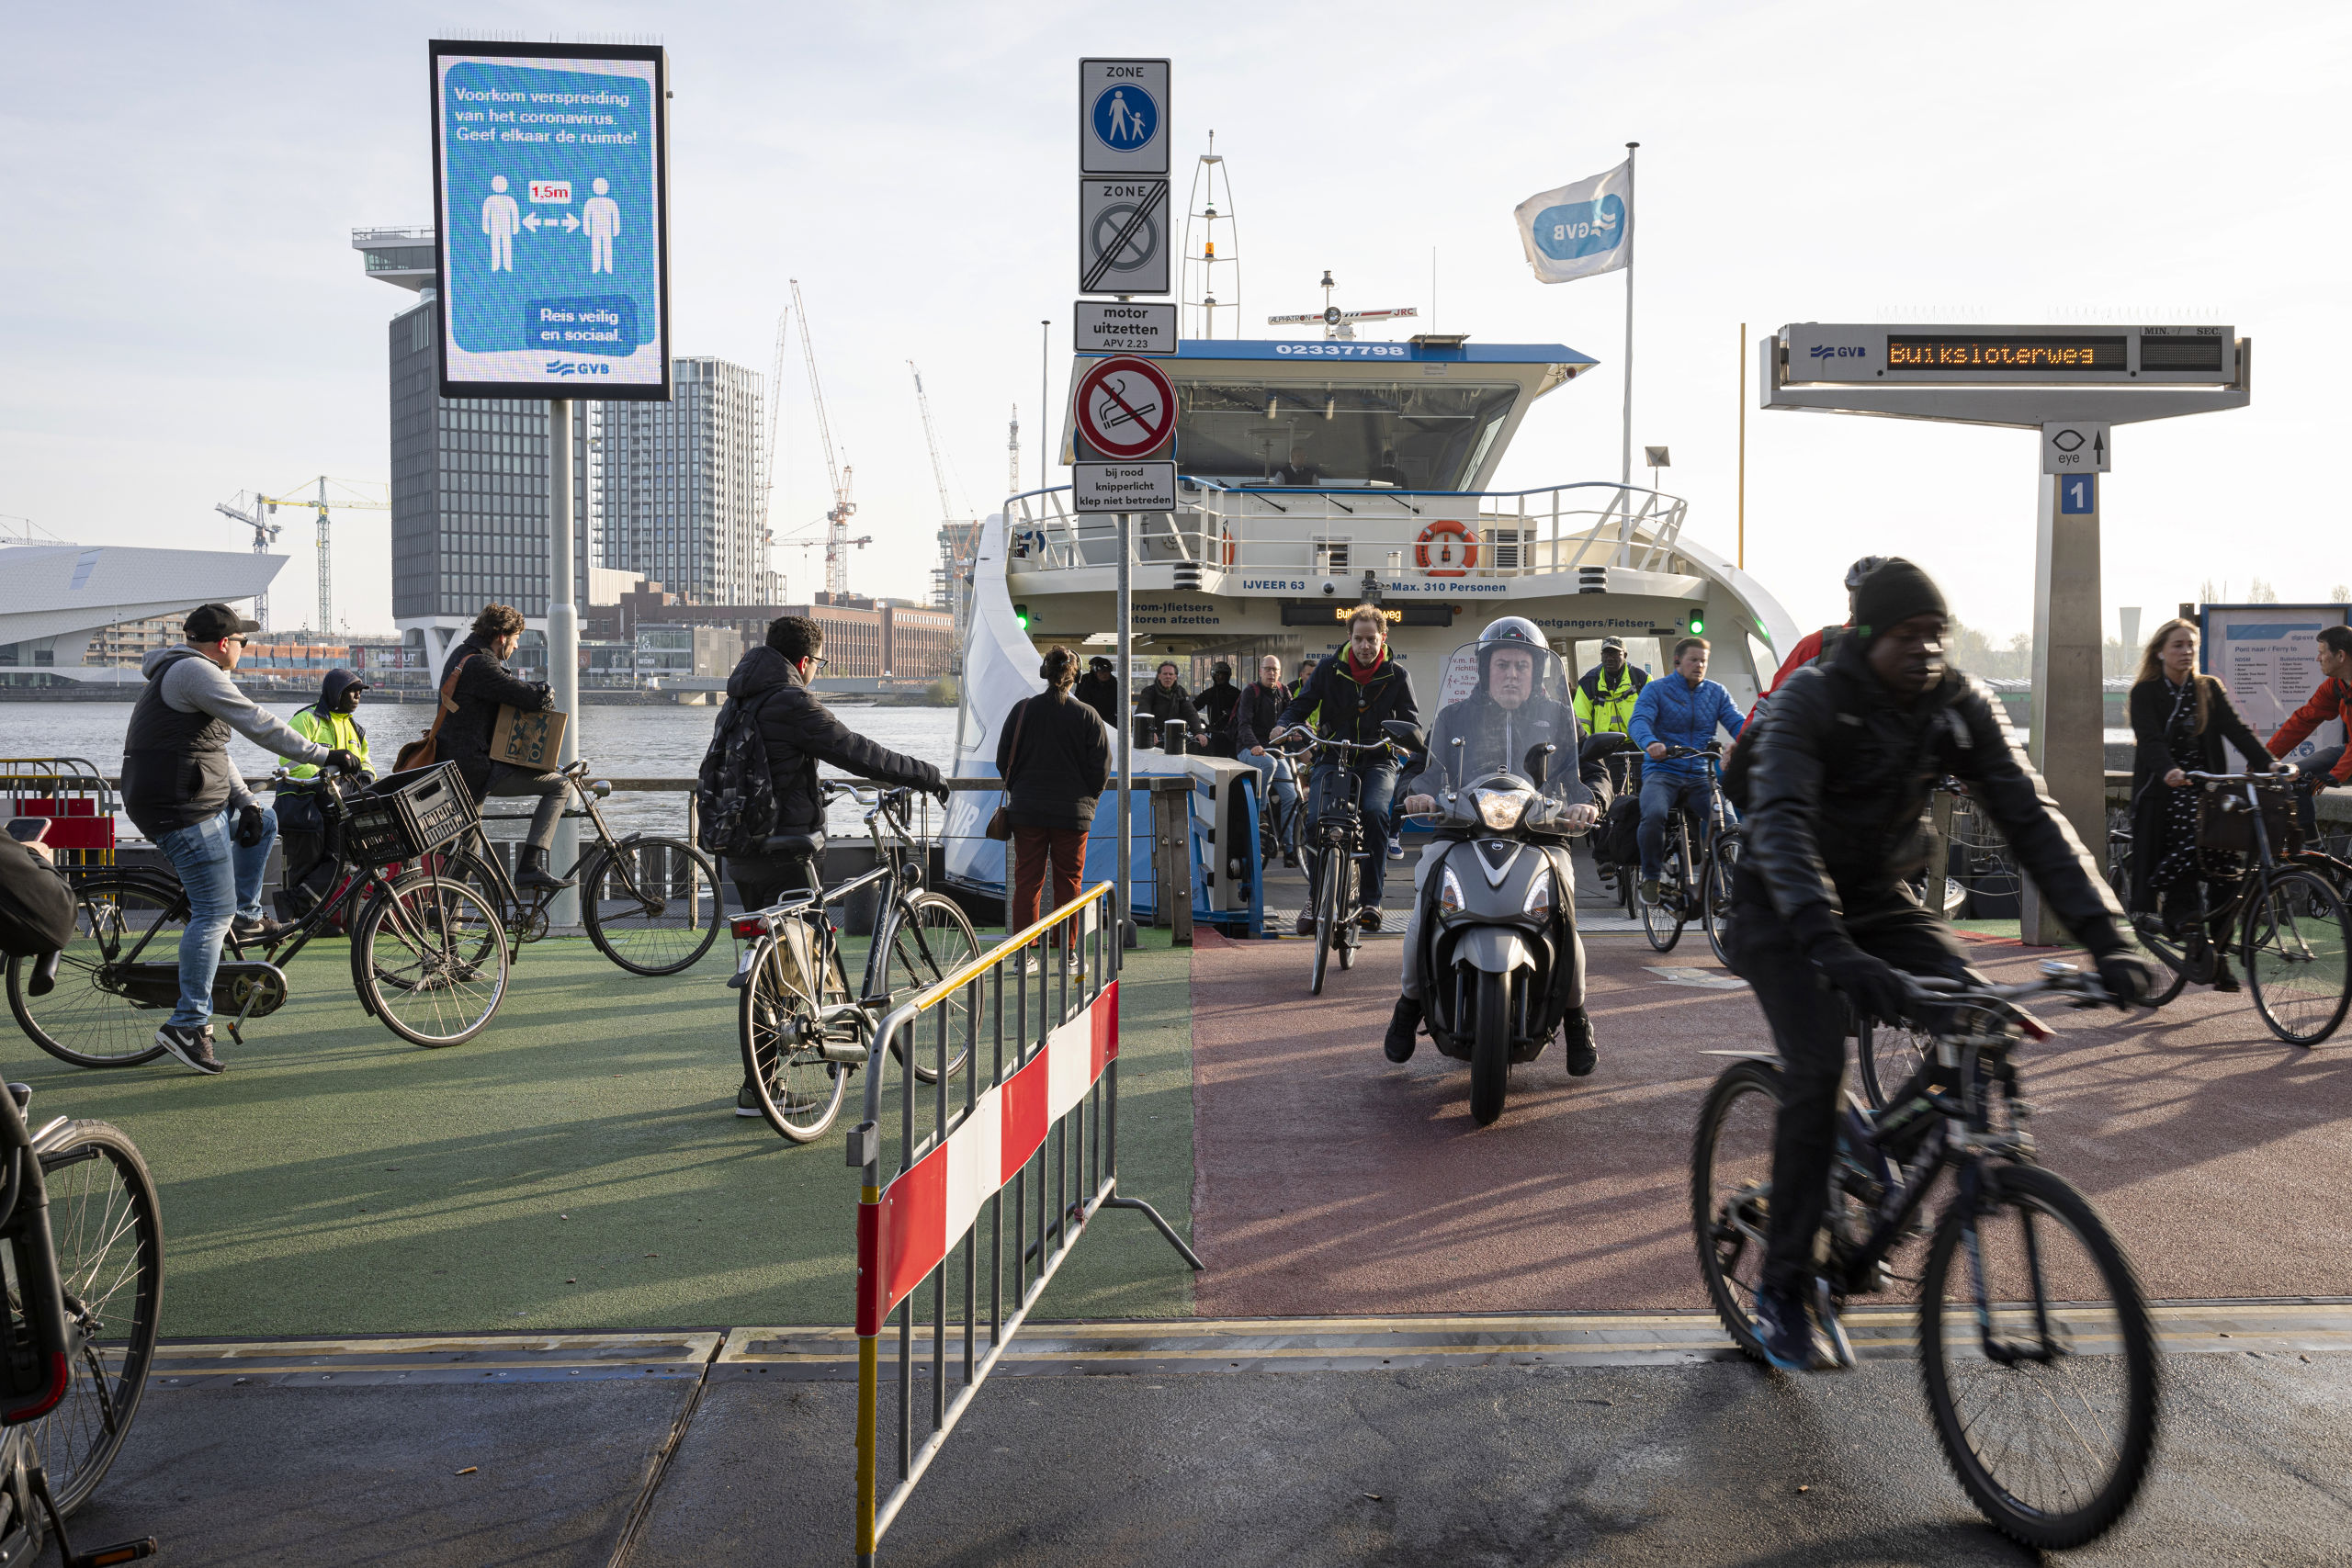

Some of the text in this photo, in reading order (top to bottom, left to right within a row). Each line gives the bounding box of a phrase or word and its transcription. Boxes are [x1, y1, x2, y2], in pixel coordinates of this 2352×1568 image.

[1106, 66, 1144, 77] ZONE
[454, 86, 629, 108] Voorkom verspreiding
[456, 107, 618, 125] van het coronavirus.
[457, 128, 638, 145] Geef elkaar de ruimte!
[532, 186, 569, 200] 1,5m
[1104, 186, 1146, 197] ZONE
[540, 308, 619, 325] Reis veilig
[1103, 309, 1148, 319] motor
[1393, 308, 1414, 317] JRC
[1271, 314, 1311, 323] ALPHATRON
[540, 327, 623, 342] en sociaal.
[1093, 323, 1159, 335] uitzetten
[2144, 327, 2170, 335] MIN.
[2197, 327, 2222, 335] SEC.
[1102, 340, 1148, 348] APV 2.23
[1276, 344, 1405, 356] 02337798
[1837, 346, 1866, 357] GVB
[1890, 342, 2094, 366] Buiksloterweg
[577, 363, 610, 375] GVB
[2058, 454, 2080, 466] eye
[1105, 468, 1143, 479] bij rood
[1095, 482, 1154, 493] knipperlicht
[2071, 482, 2084, 508] 1
[1080, 496, 1170, 507] klep niet betreden
[1243, 581, 1305, 590] IJVEER 63
[1392, 582, 1507, 592] Max. 310 Personen
[1170, 615, 1220, 624] afzetten
[1530, 618, 1656, 628] Voetgangers/Fietsers
